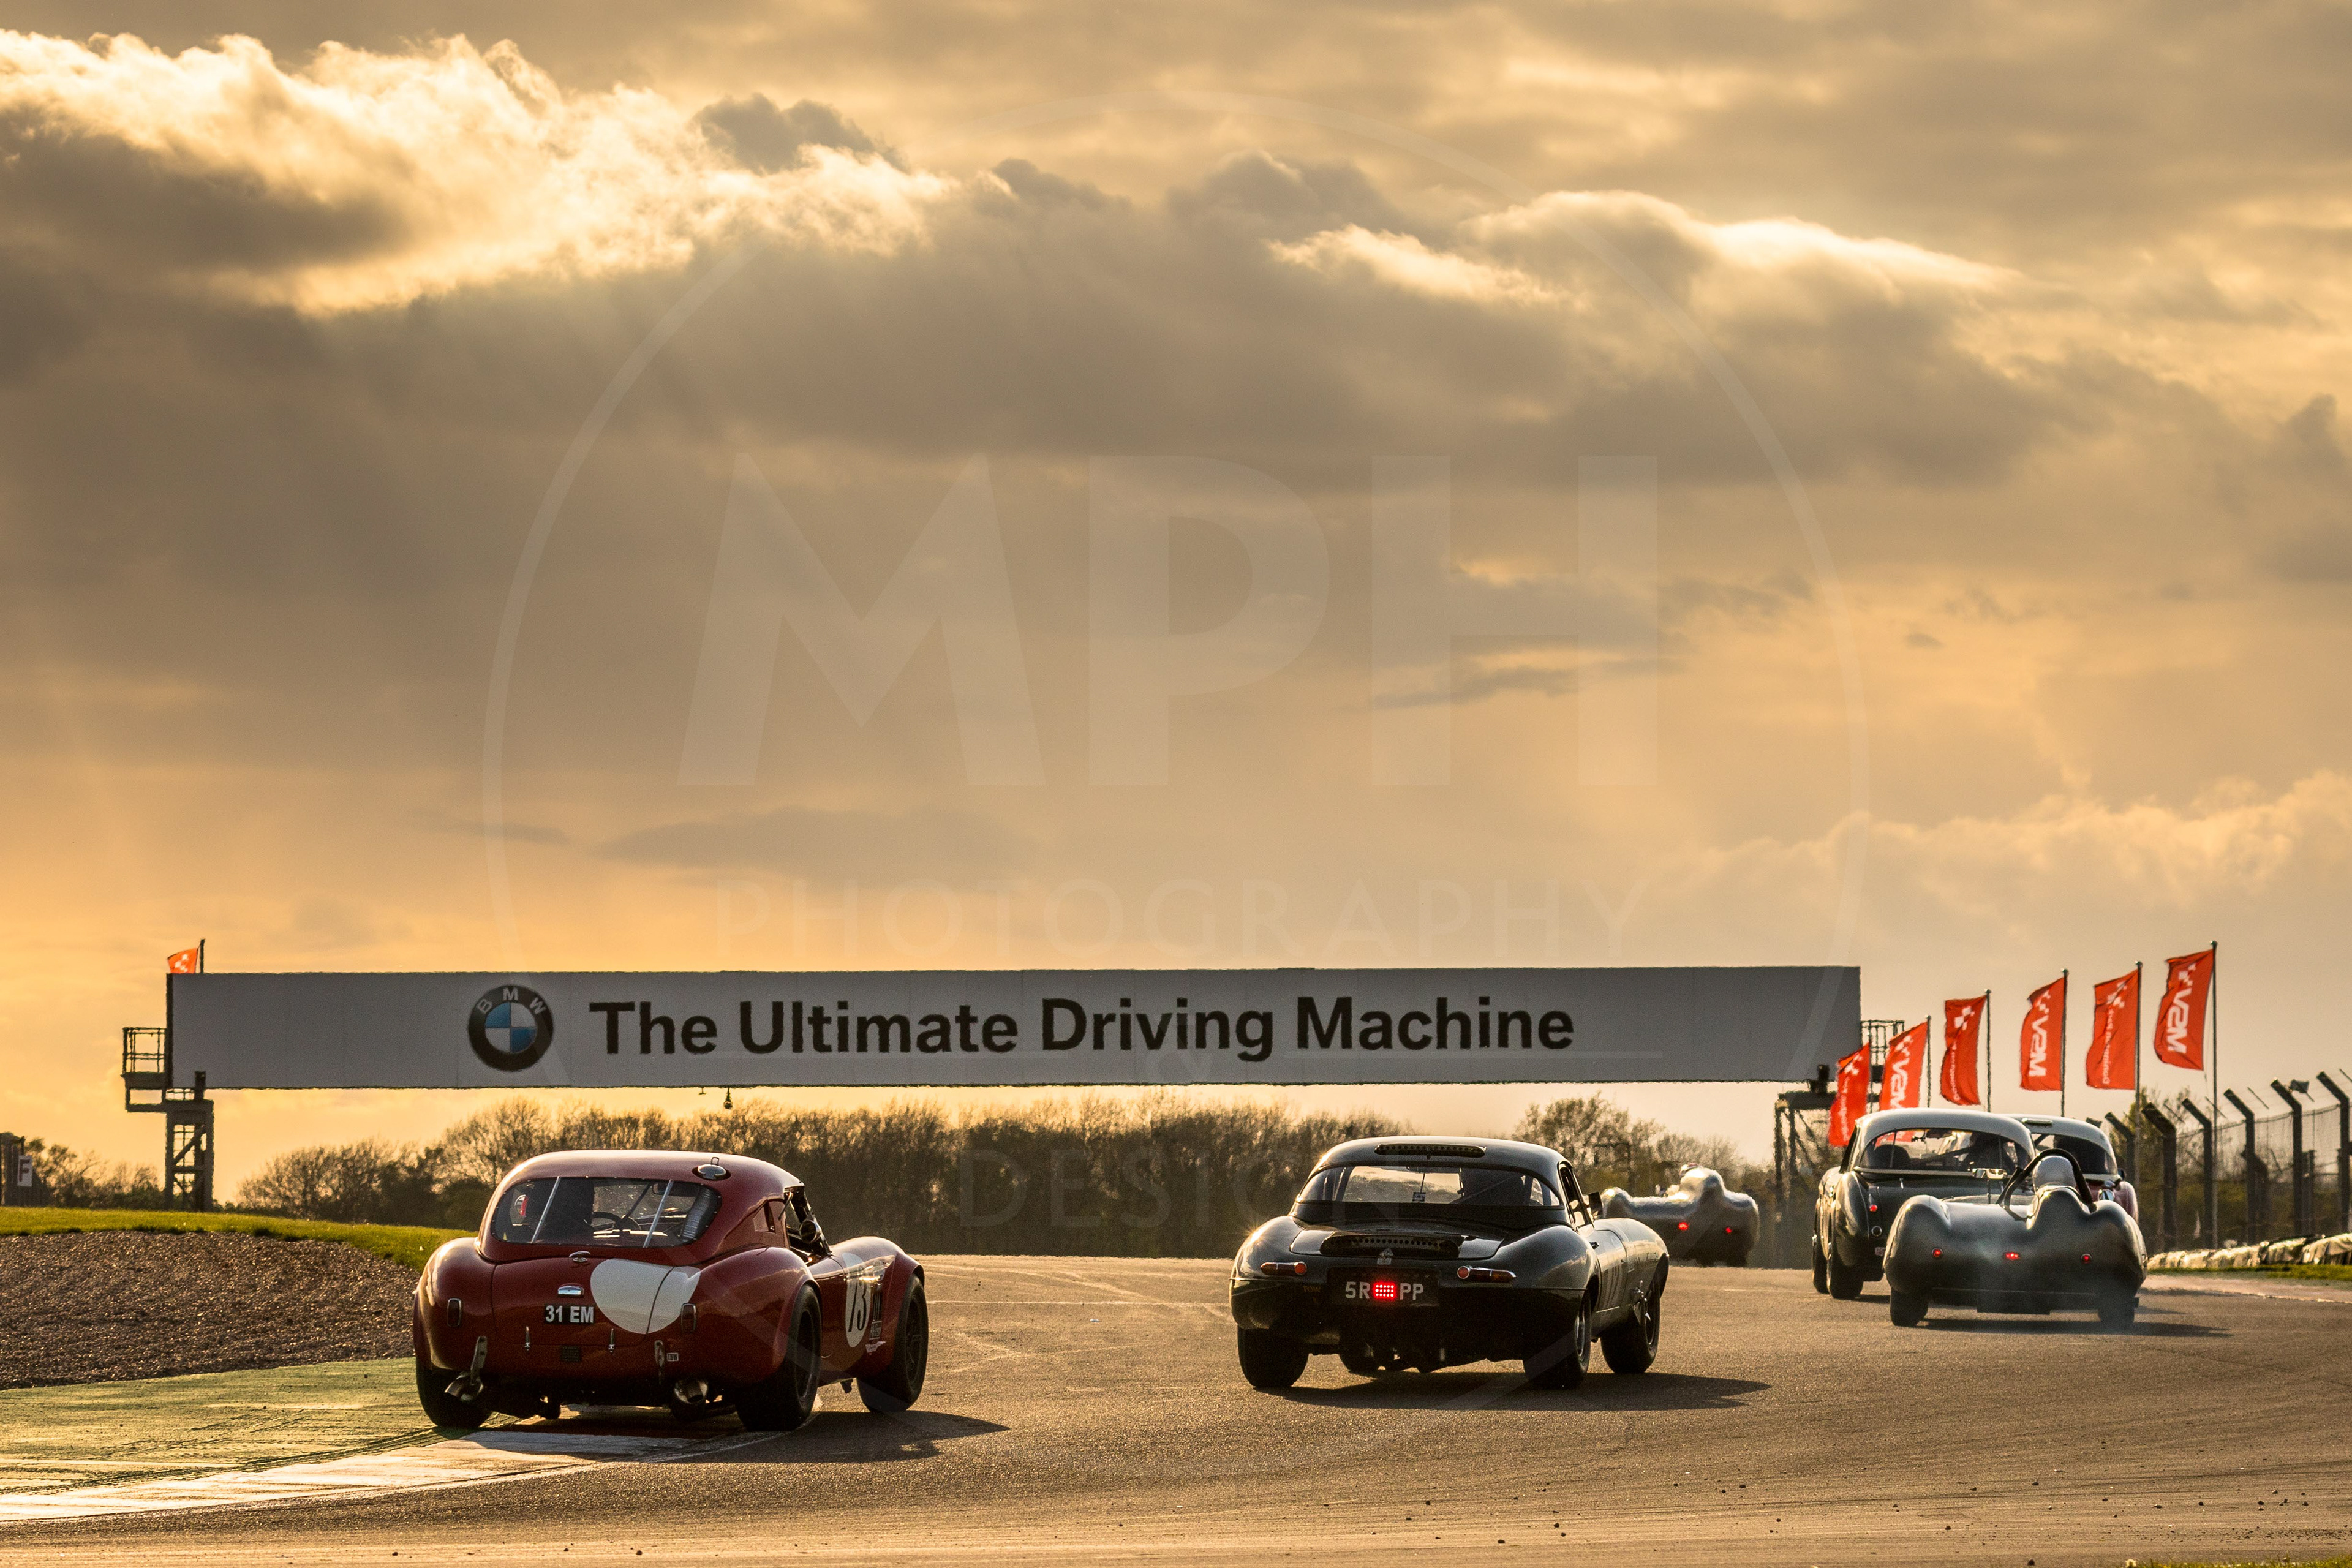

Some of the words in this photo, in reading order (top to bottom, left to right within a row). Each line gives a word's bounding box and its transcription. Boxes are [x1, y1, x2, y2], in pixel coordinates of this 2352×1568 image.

[477, 987, 546, 1014] BMW
[589, 1001, 717, 1054] The
[739, 1001, 1018, 1054] Ultimate
[1042, 997, 1273, 1062] Driving
[1297, 996, 1574, 1050] Machine
[19, 1159, 31, 1182] F
[545, 1305, 563, 1322] 31
[570, 1306, 594, 1323] EM
